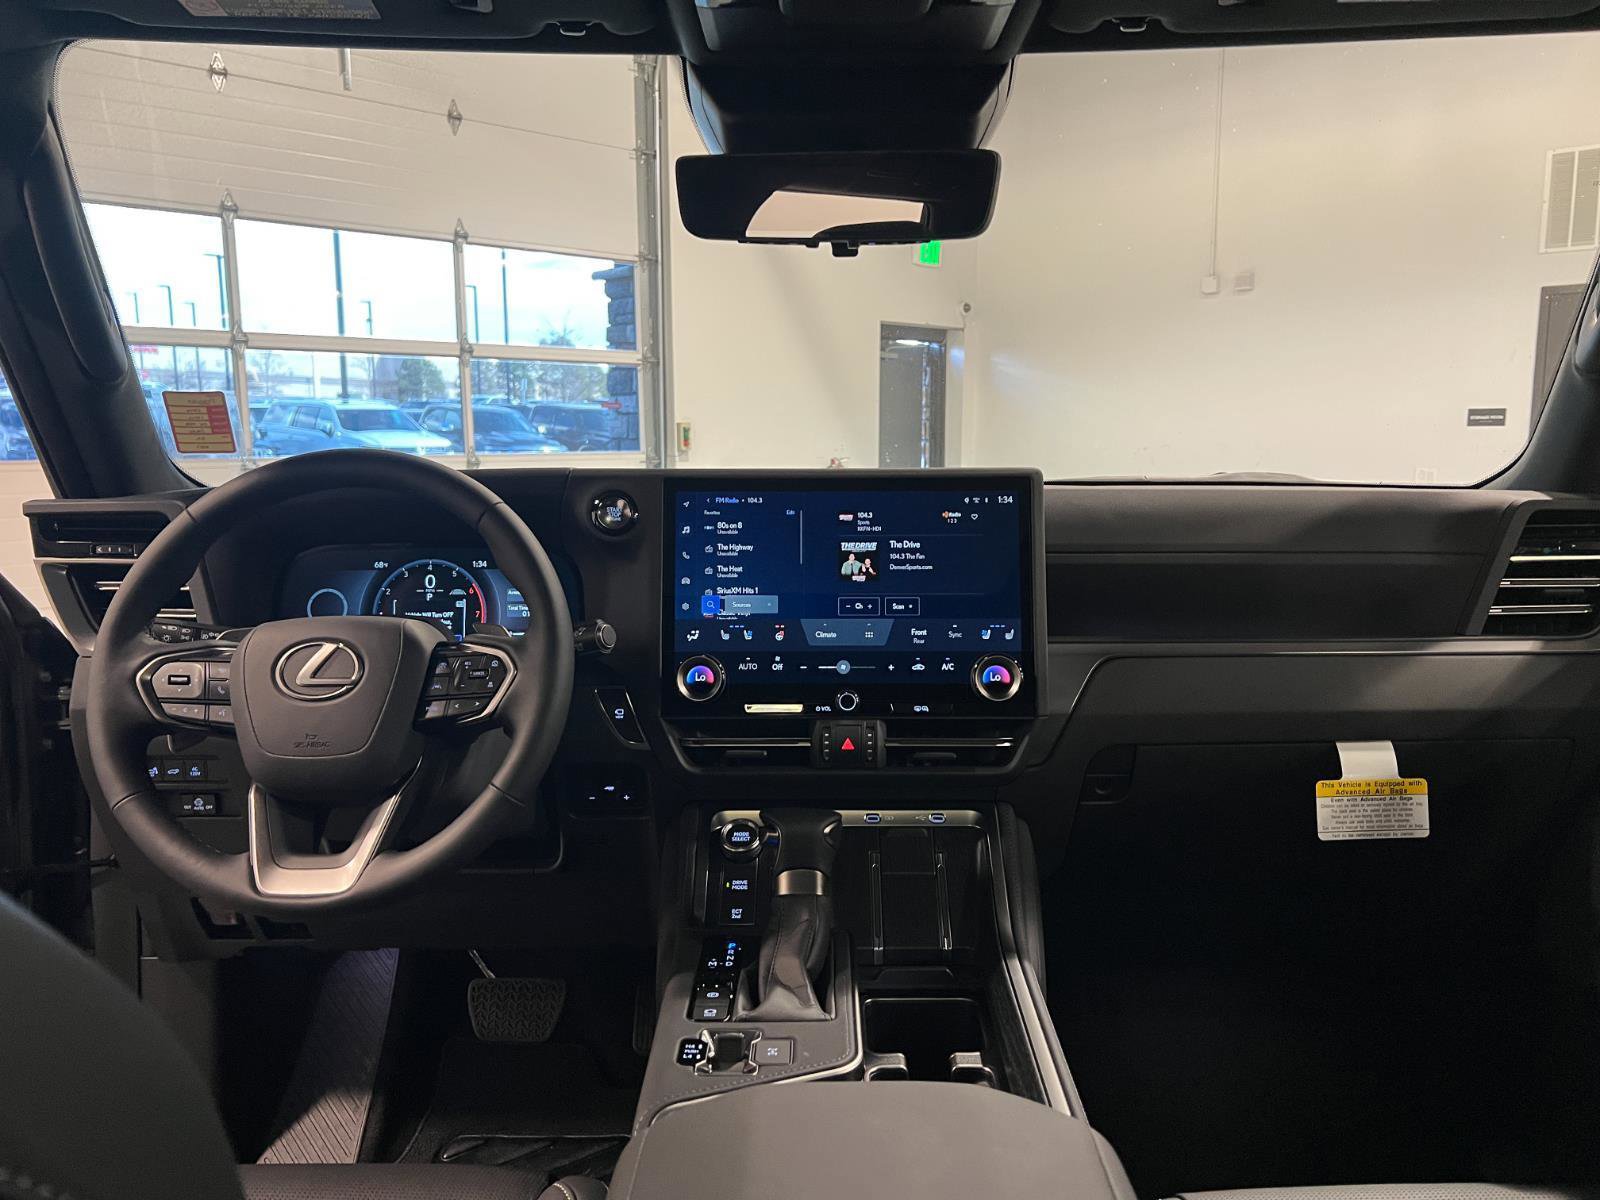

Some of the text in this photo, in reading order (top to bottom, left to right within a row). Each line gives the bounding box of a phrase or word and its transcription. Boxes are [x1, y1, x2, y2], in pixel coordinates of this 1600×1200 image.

[998, 495, 1013, 504] 1:34
[717, 521, 729, 529] 80s
[737, 521, 743, 529] 8
[717, 543, 753, 552] The Highway
[855, 541, 877, 551] DRIVE
[889, 540, 921, 549] The Drive
[472, 560, 487, 568] 1:34
[424, 574, 436, 589] 0
[426, 593, 433, 601] P
[815, 630, 837, 639] Climate
[911, 628, 927, 636] Front
[948, 630, 962, 639] Sync
[738, 663, 758, 671] AUTO
[772, 663, 784, 671] Off
[941, 663, 955, 671] A/C
[695, 671, 706, 682] Lo
[989, 671, 1001, 682] Lo
